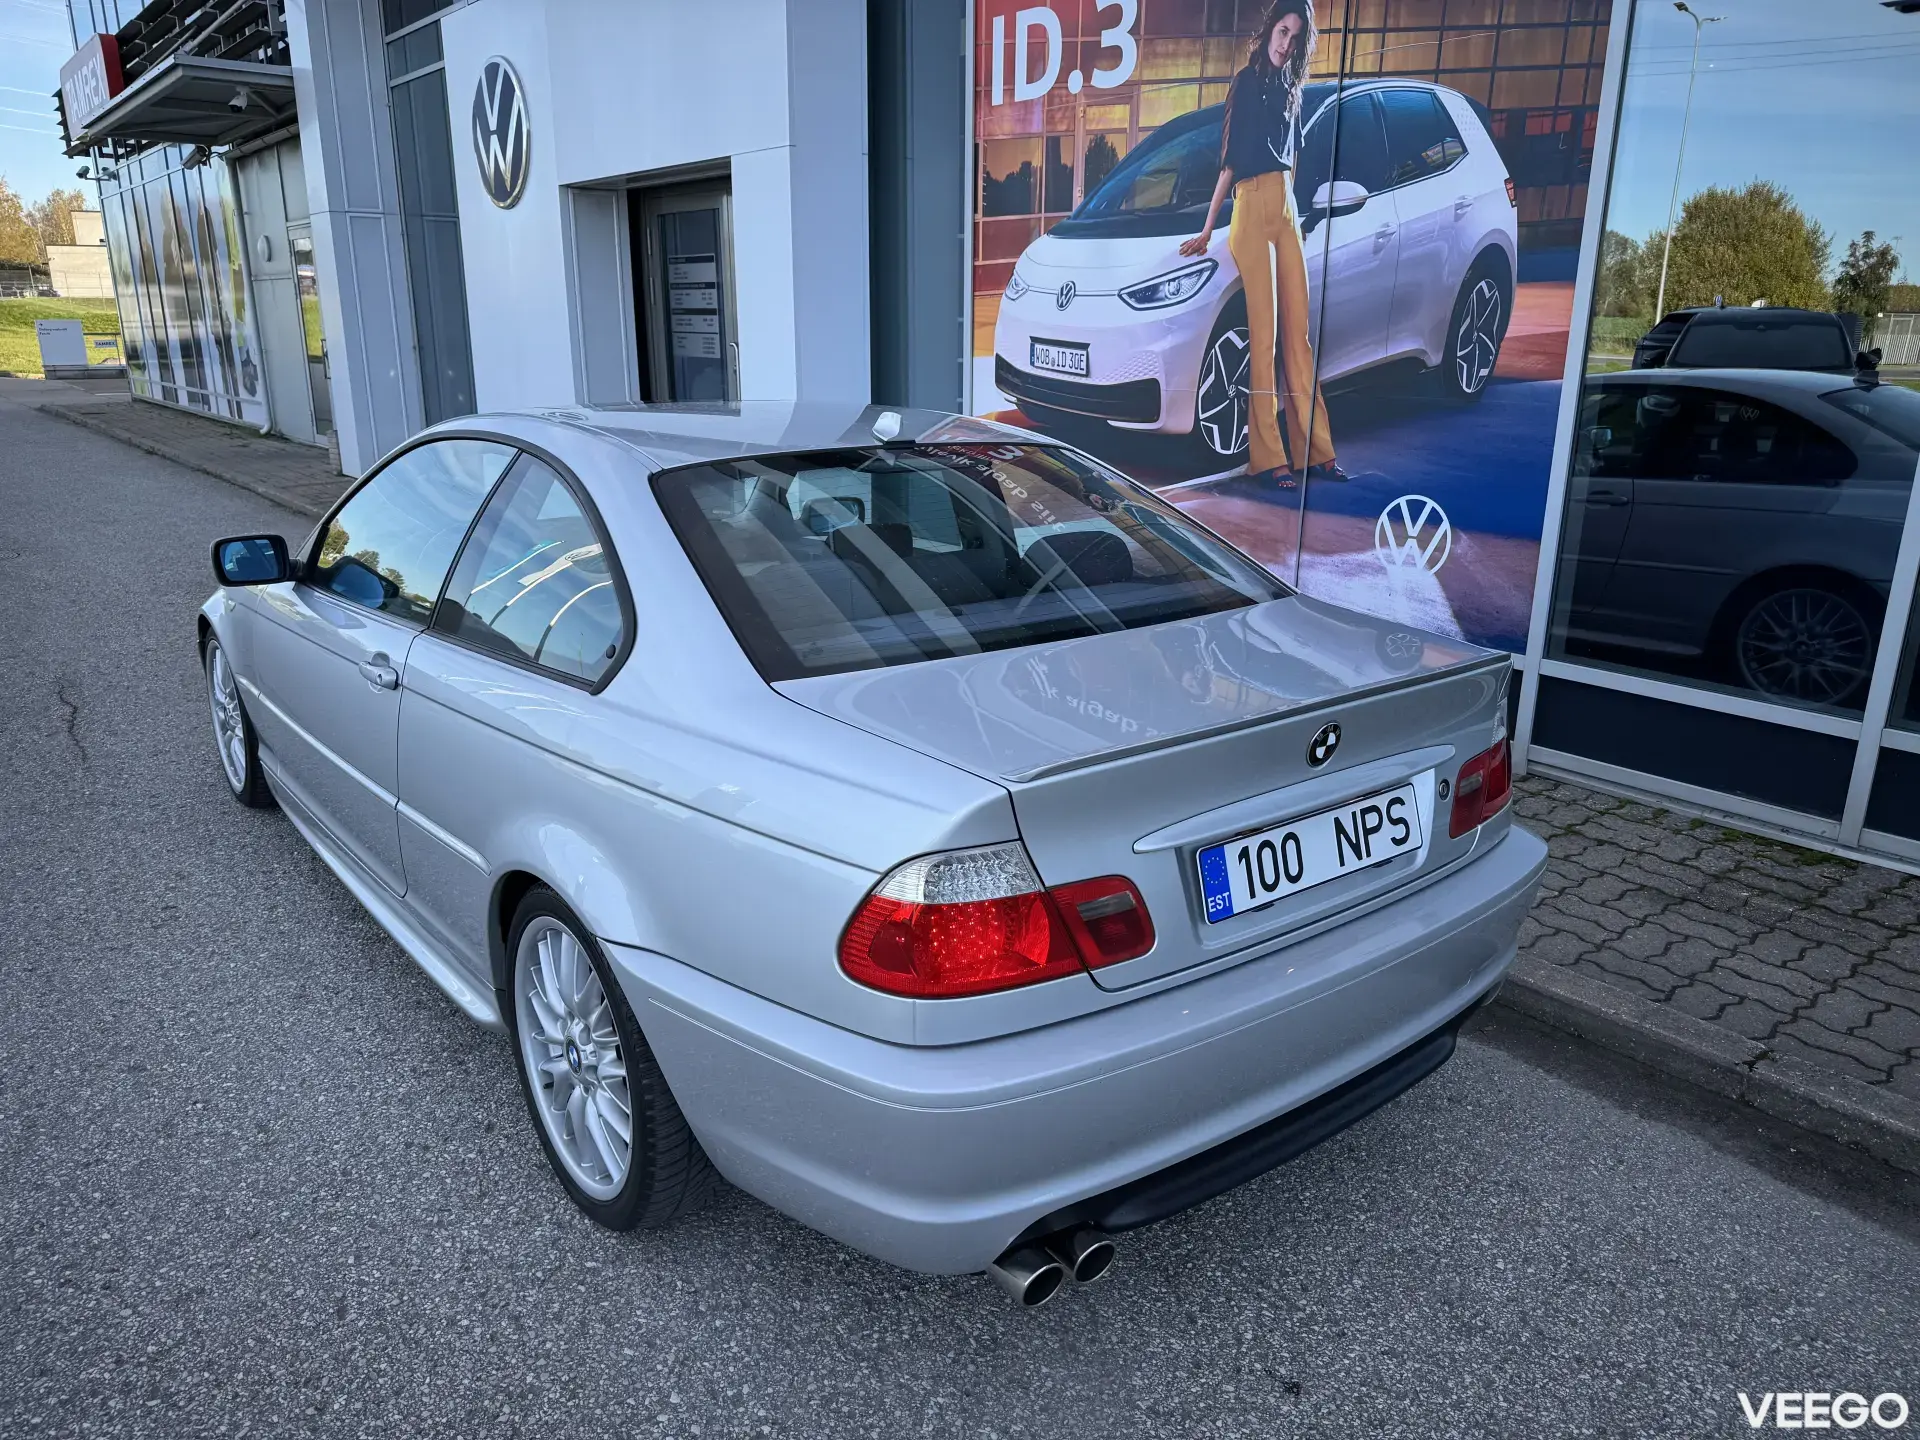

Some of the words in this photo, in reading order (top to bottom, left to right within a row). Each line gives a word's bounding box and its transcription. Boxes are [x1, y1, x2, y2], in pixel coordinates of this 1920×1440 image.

[64, 53, 106, 123] TAMREX
[992, 0, 1137, 106] ID.3
[472, 55, 531, 209] VW
[1035, 347, 1050, 365] WOB
[1057, 350, 1067, 368] ID
[1238, 831, 1304, 900] 100
[1333, 796, 1411, 868] NPS
[1208, 892, 1231, 912] EST
